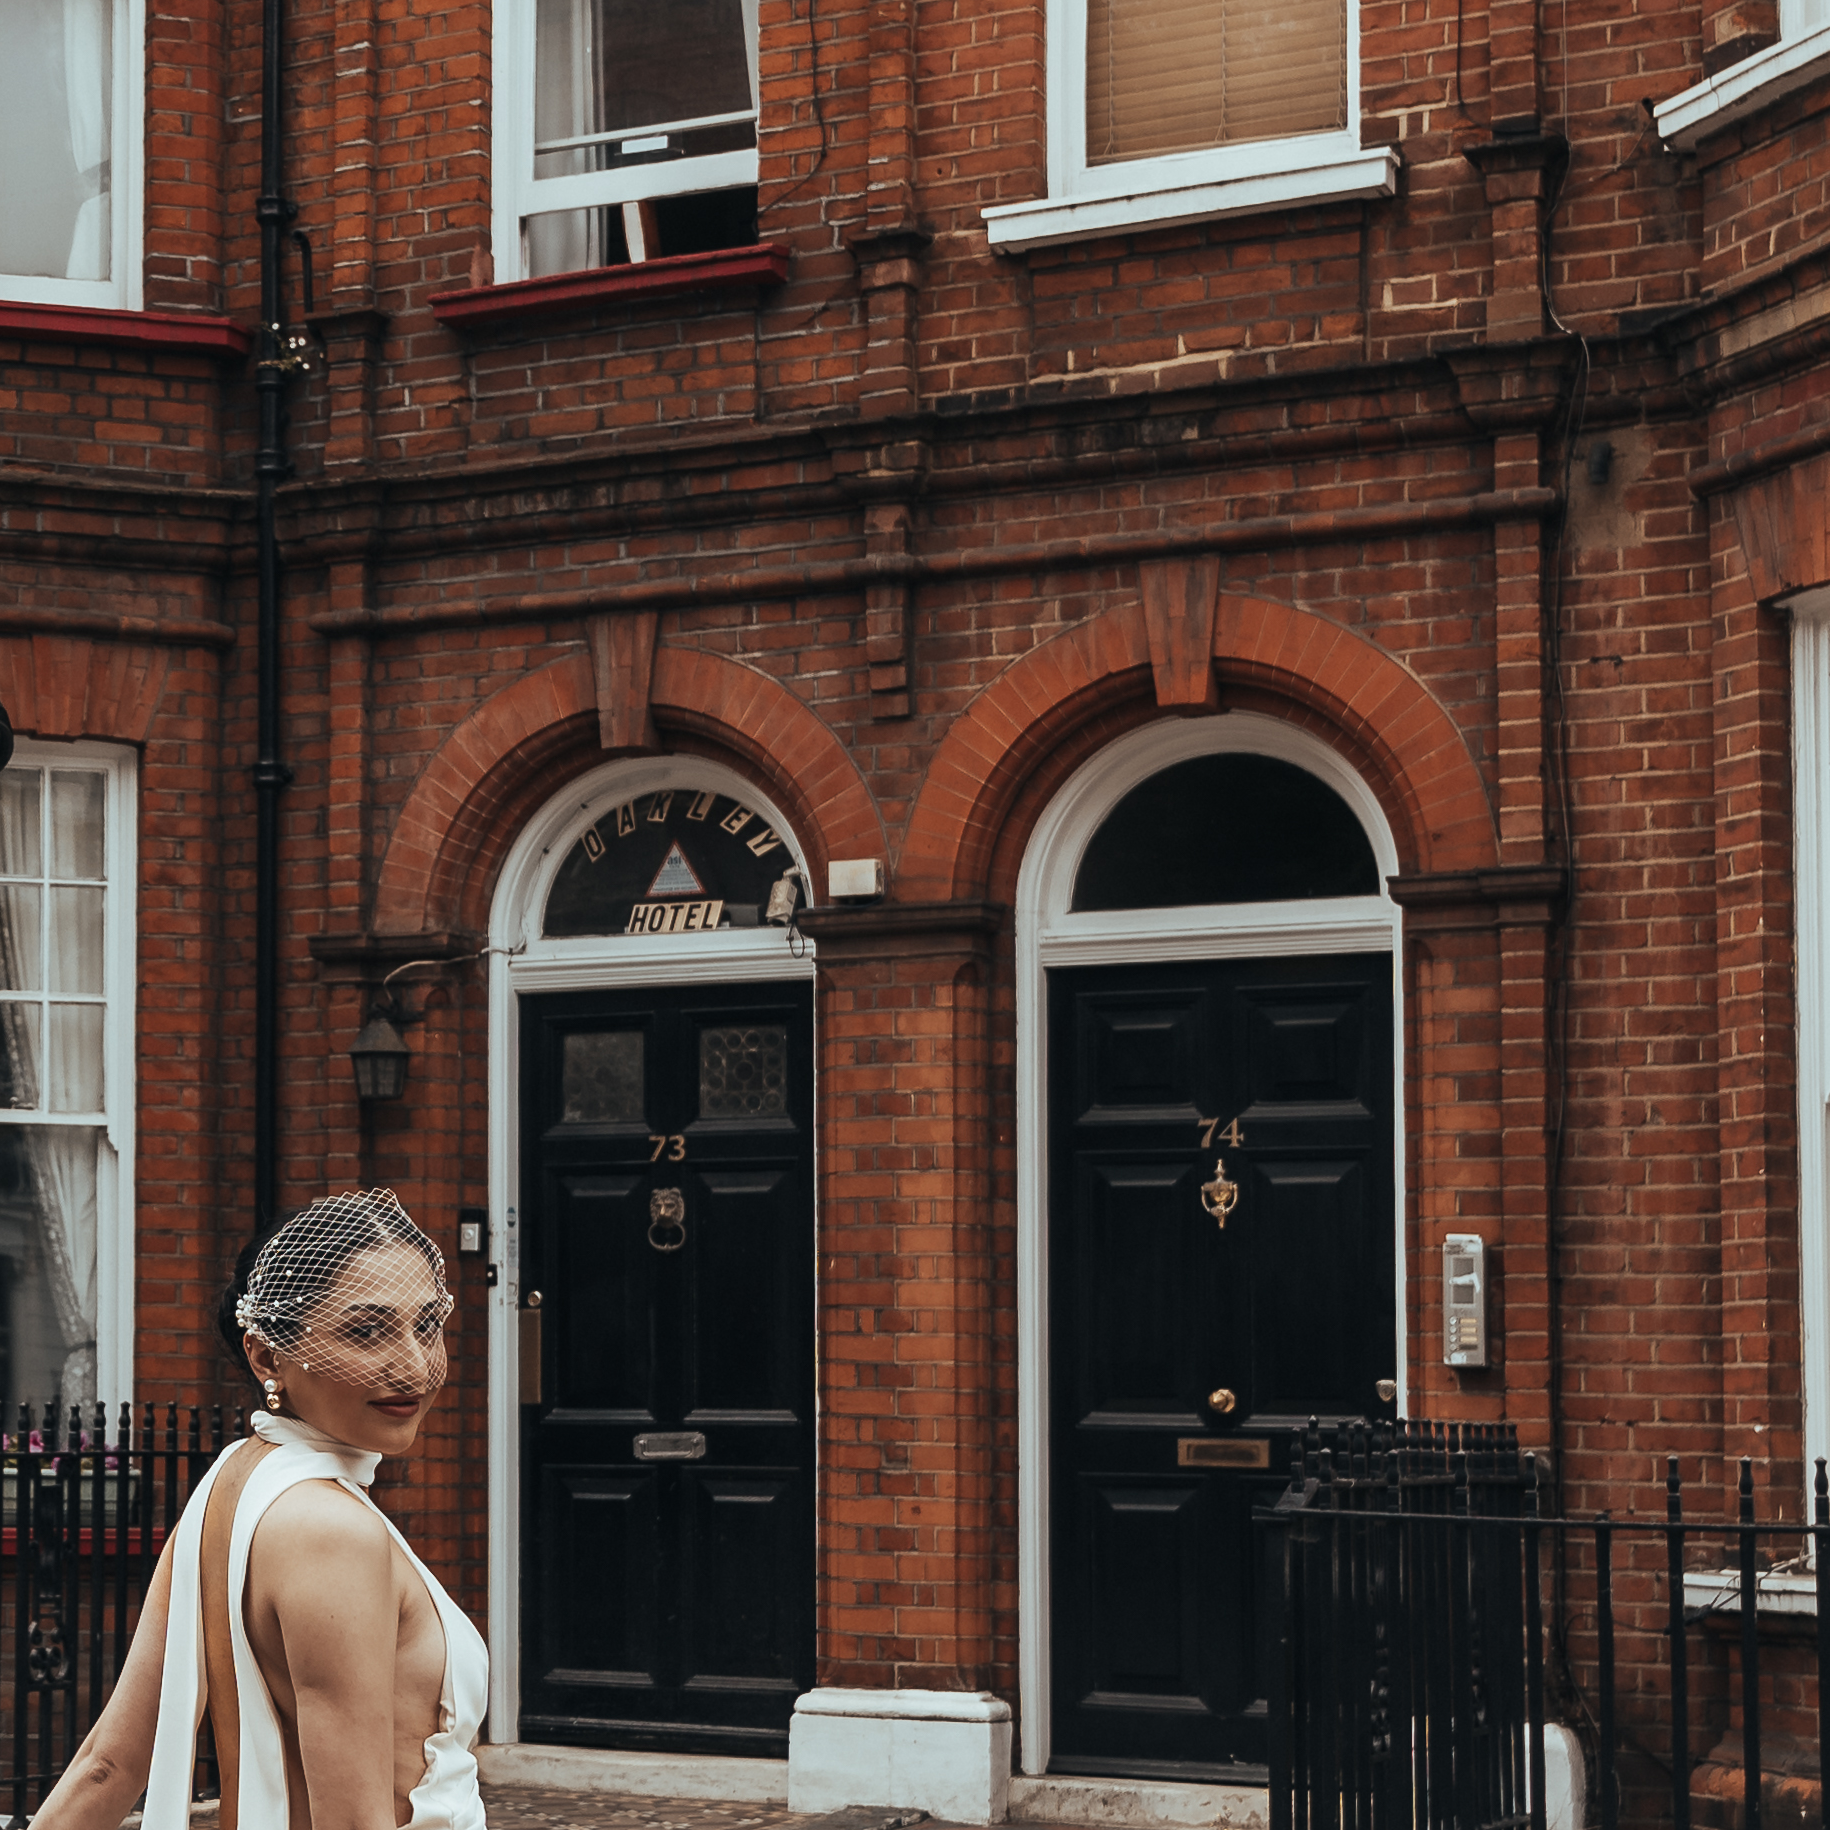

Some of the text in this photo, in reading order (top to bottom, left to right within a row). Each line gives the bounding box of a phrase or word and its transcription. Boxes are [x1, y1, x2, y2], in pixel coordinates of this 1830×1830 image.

[580, 792, 781, 860] OAKLEY
[629, 902, 716, 933] HOTEL
[1198, 1117, 1244, 1148] 74
[648, 1135, 686, 1162] 73
